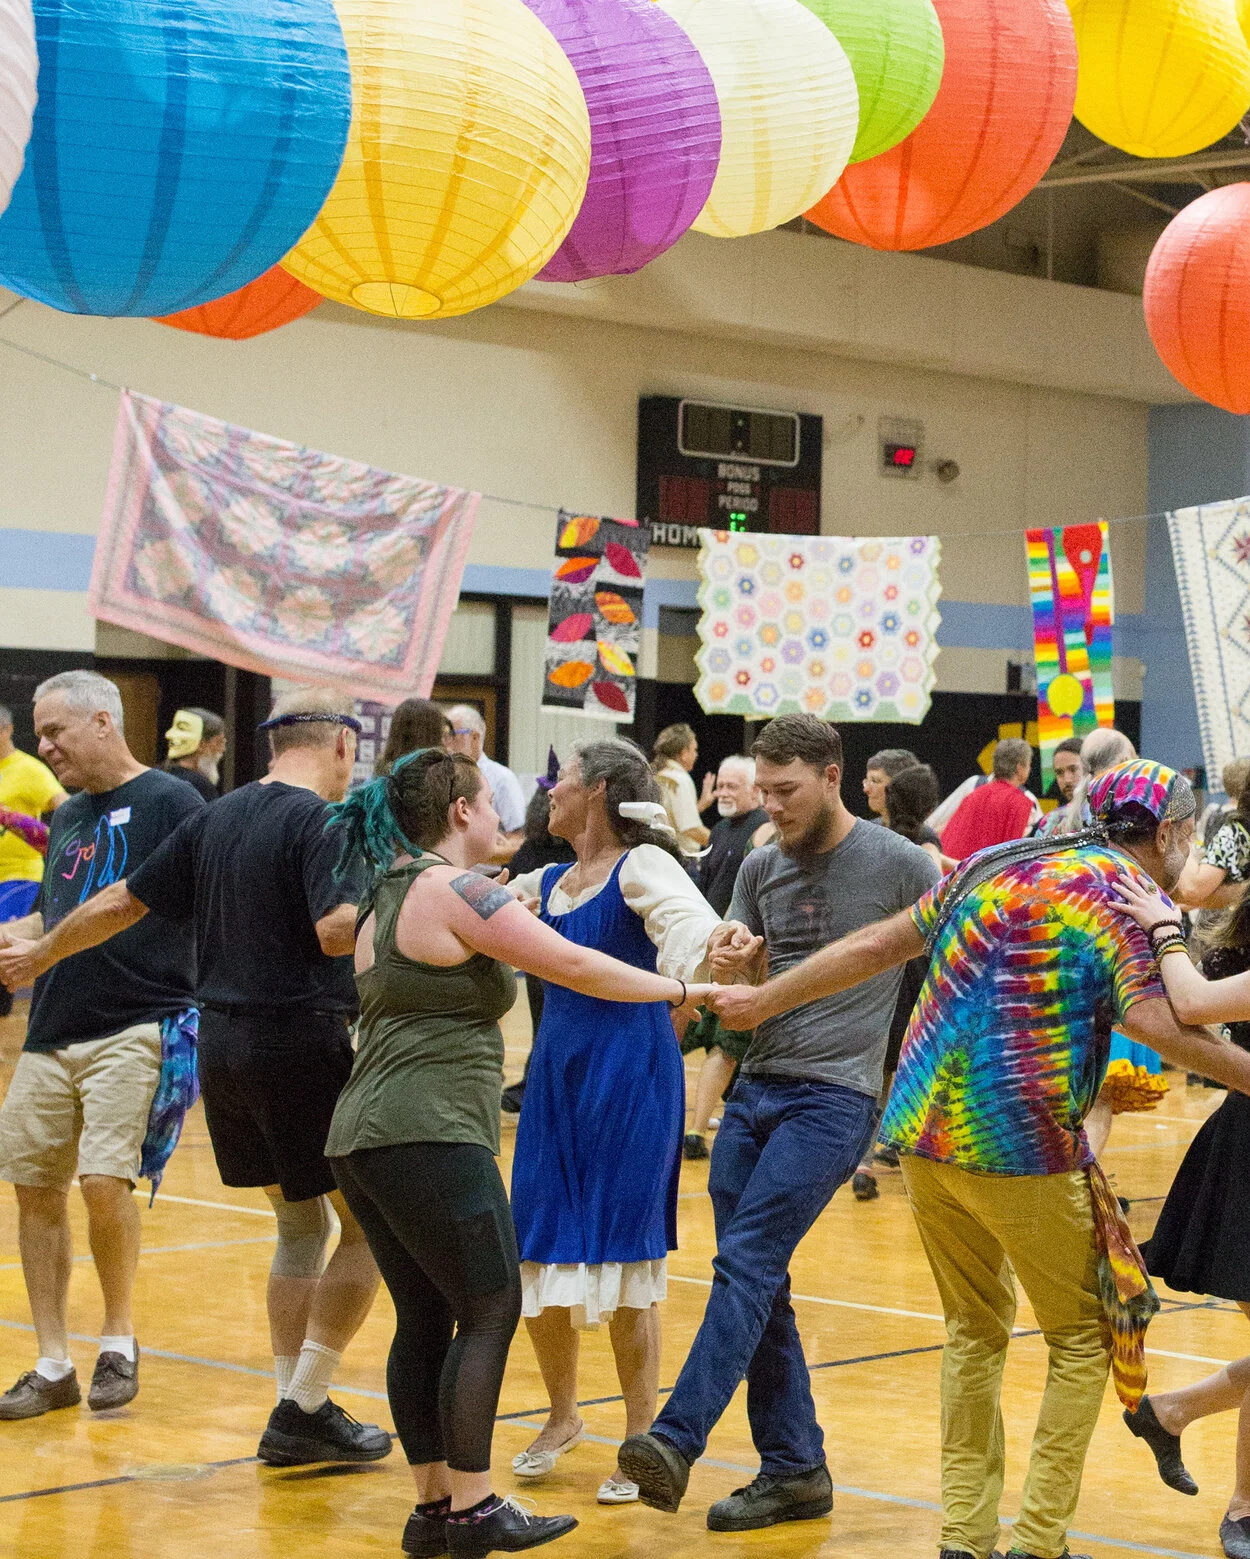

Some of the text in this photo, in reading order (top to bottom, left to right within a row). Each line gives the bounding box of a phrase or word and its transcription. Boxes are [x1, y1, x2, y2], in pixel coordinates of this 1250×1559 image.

[717, 463, 760, 482] BONUS
[718, 494, 759, 512] PERIOD
[652, 522, 700, 546] HOM
